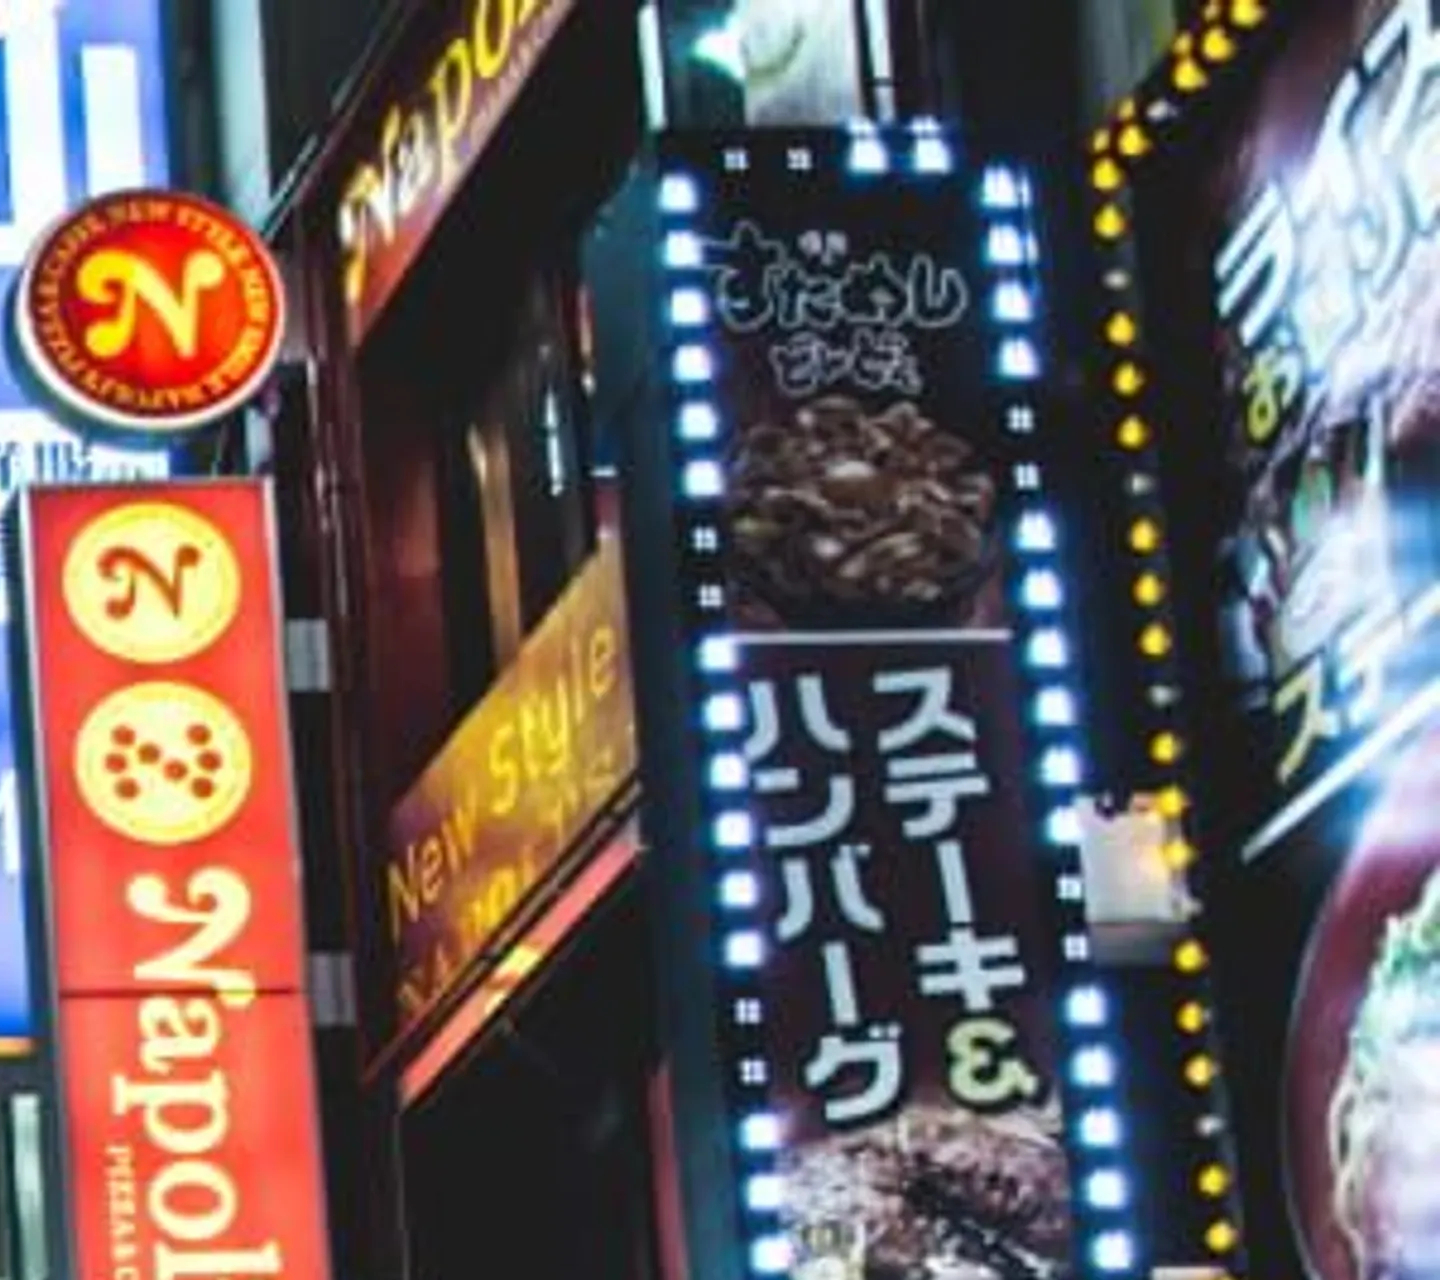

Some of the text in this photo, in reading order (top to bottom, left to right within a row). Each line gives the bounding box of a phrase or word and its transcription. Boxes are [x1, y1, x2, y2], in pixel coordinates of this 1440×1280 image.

[742, 674, 905, 1124] ハンバーグ
